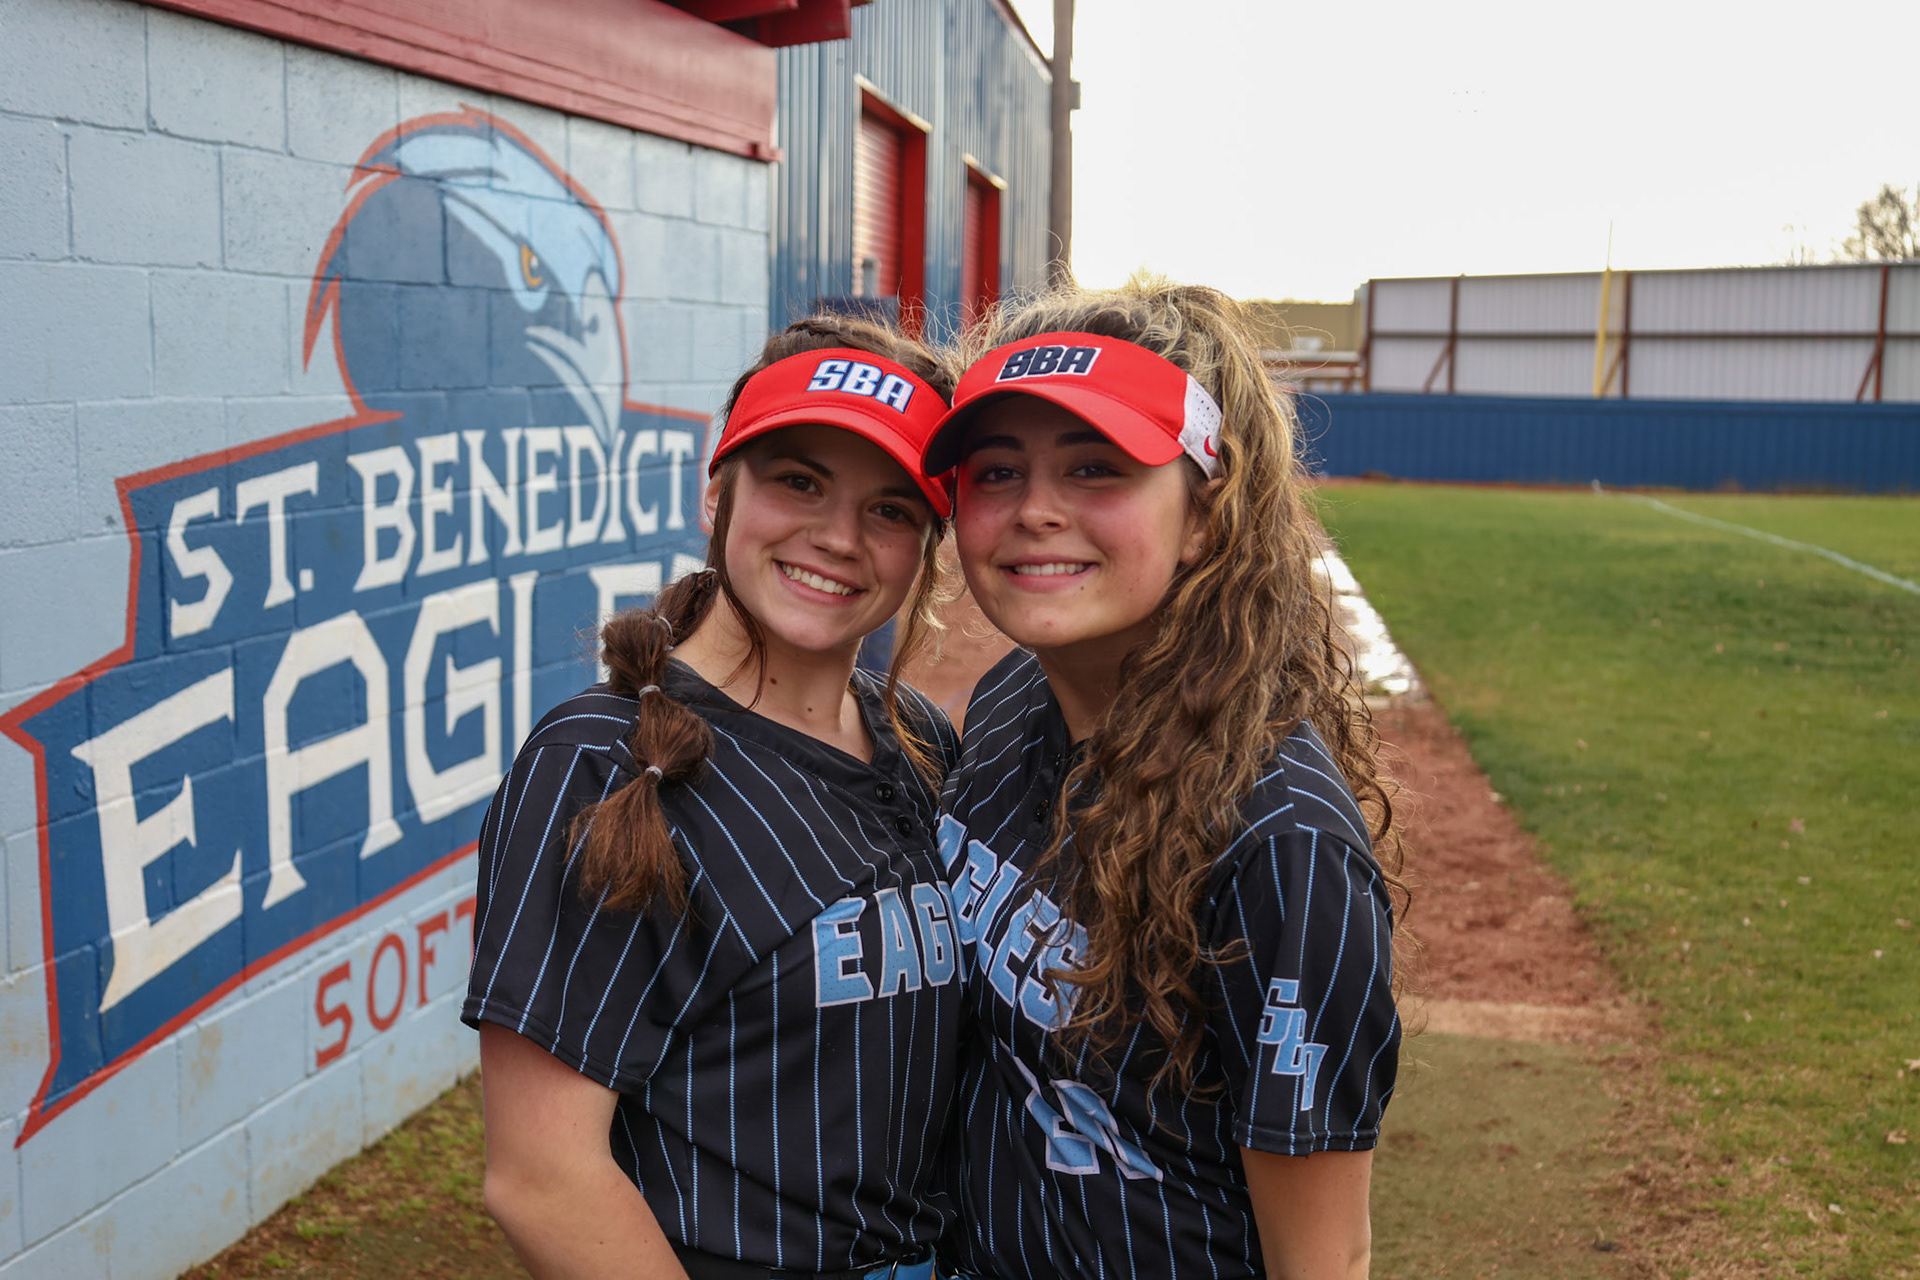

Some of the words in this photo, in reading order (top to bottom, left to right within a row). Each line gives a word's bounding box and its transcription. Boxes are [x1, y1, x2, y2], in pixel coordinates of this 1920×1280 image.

[806, 358, 915, 414] SBA
[994, 345, 1101, 383] SBA
[167, 460, 318, 639] ST.
[347, 425, 694, 592] BENEDICT
[71, 552, 708, 1014] EAGL
